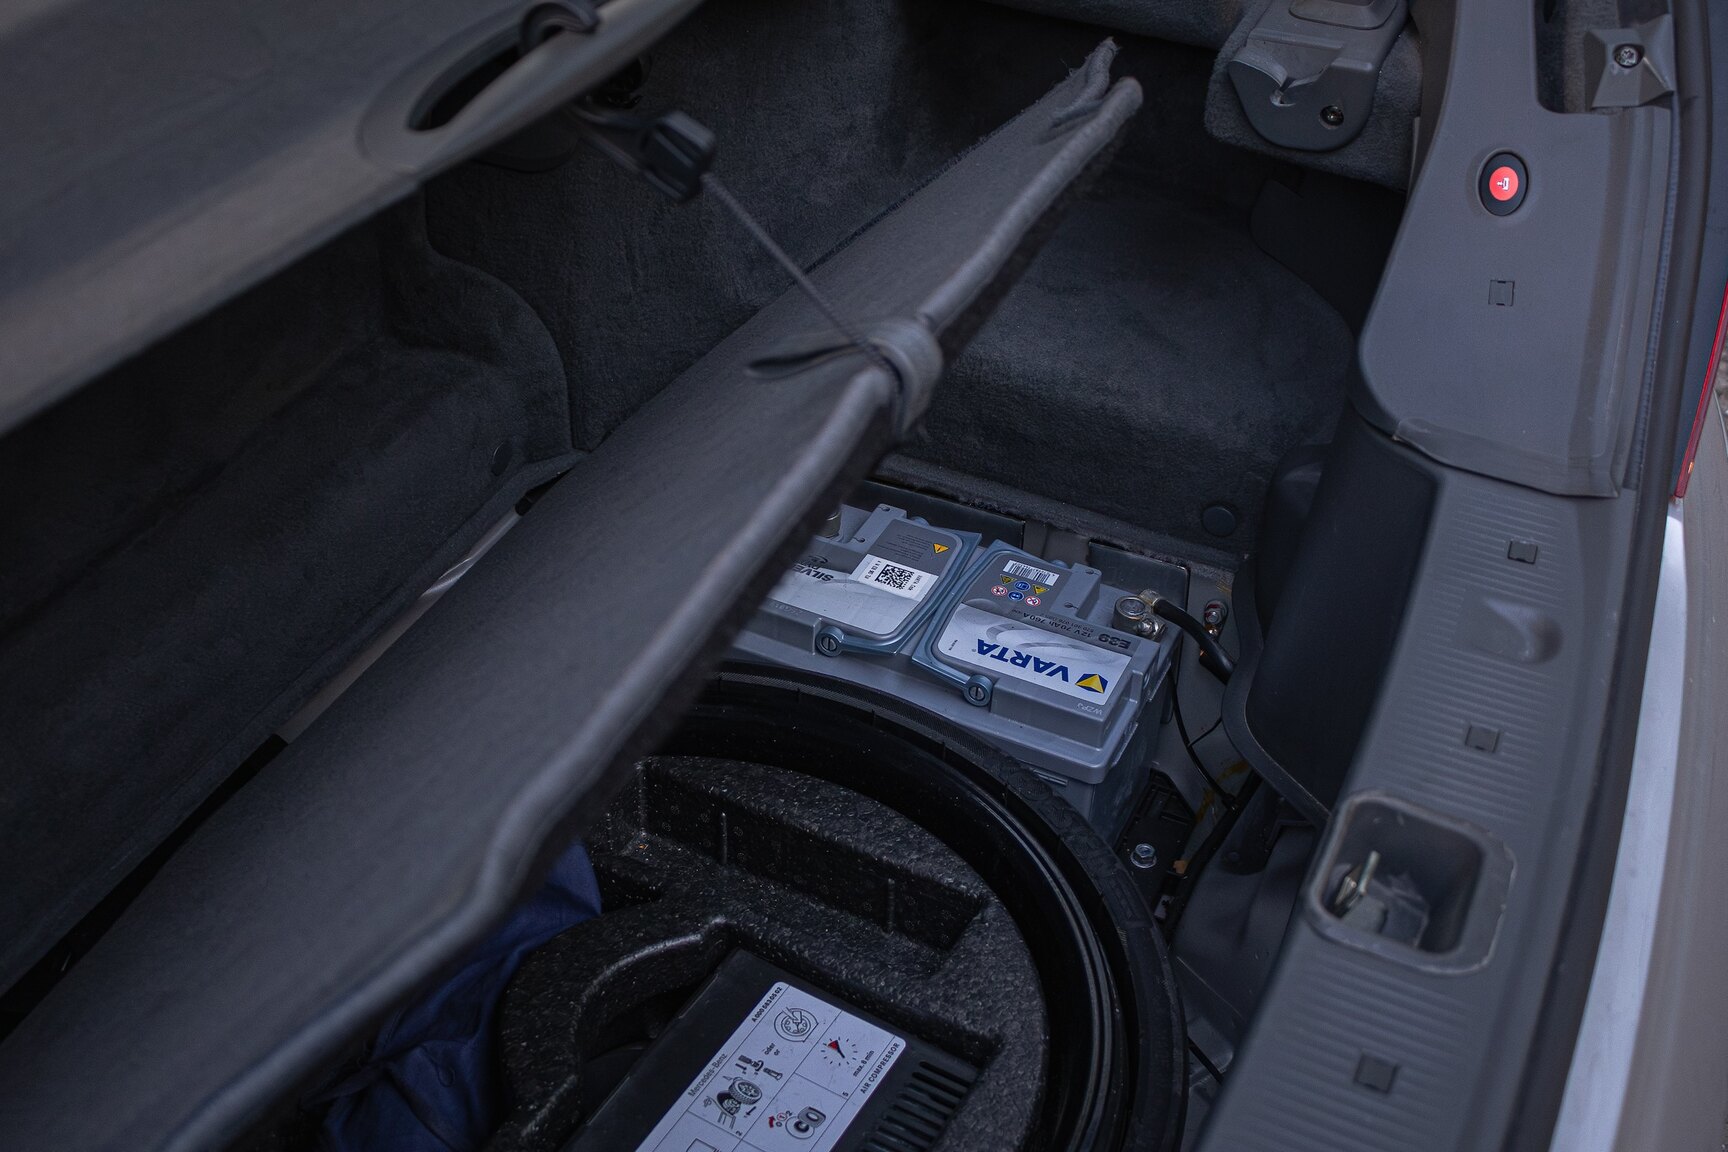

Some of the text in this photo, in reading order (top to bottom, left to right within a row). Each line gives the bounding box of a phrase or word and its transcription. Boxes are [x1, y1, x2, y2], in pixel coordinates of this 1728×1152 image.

[792, 563, 835, 582] SILVE
[977, 638, 1069, 683] VARTA
[1098, 633, 1132, 650] E39
[687, 1053, 728, 1097] Mercedes-Benz
[860, 1042, 901, 1095] AIR COMPRESSOR
